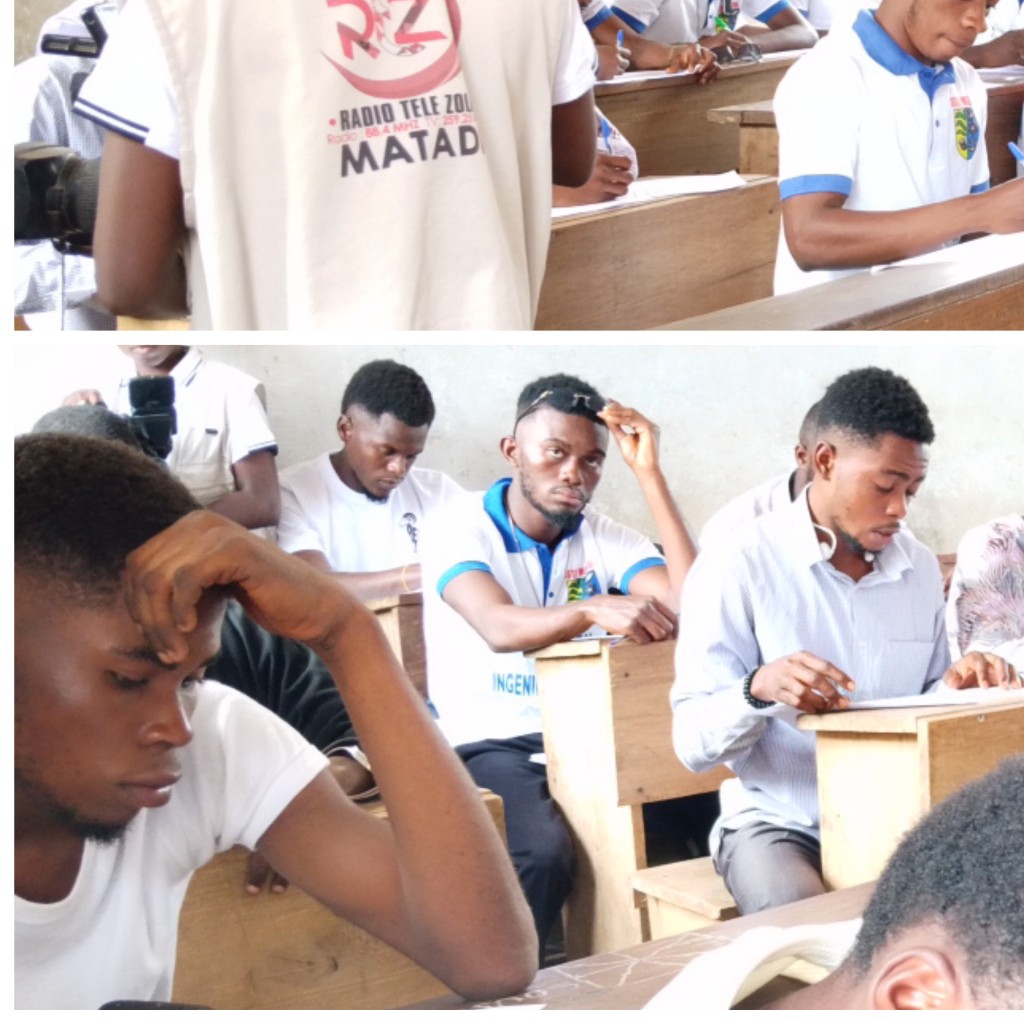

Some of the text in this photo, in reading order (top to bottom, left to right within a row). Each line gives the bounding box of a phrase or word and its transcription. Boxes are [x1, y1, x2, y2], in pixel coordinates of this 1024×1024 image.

[339, 92, 472, 131] RADIO TELE ZOL
[341, 125, 485, 178] MATAD
